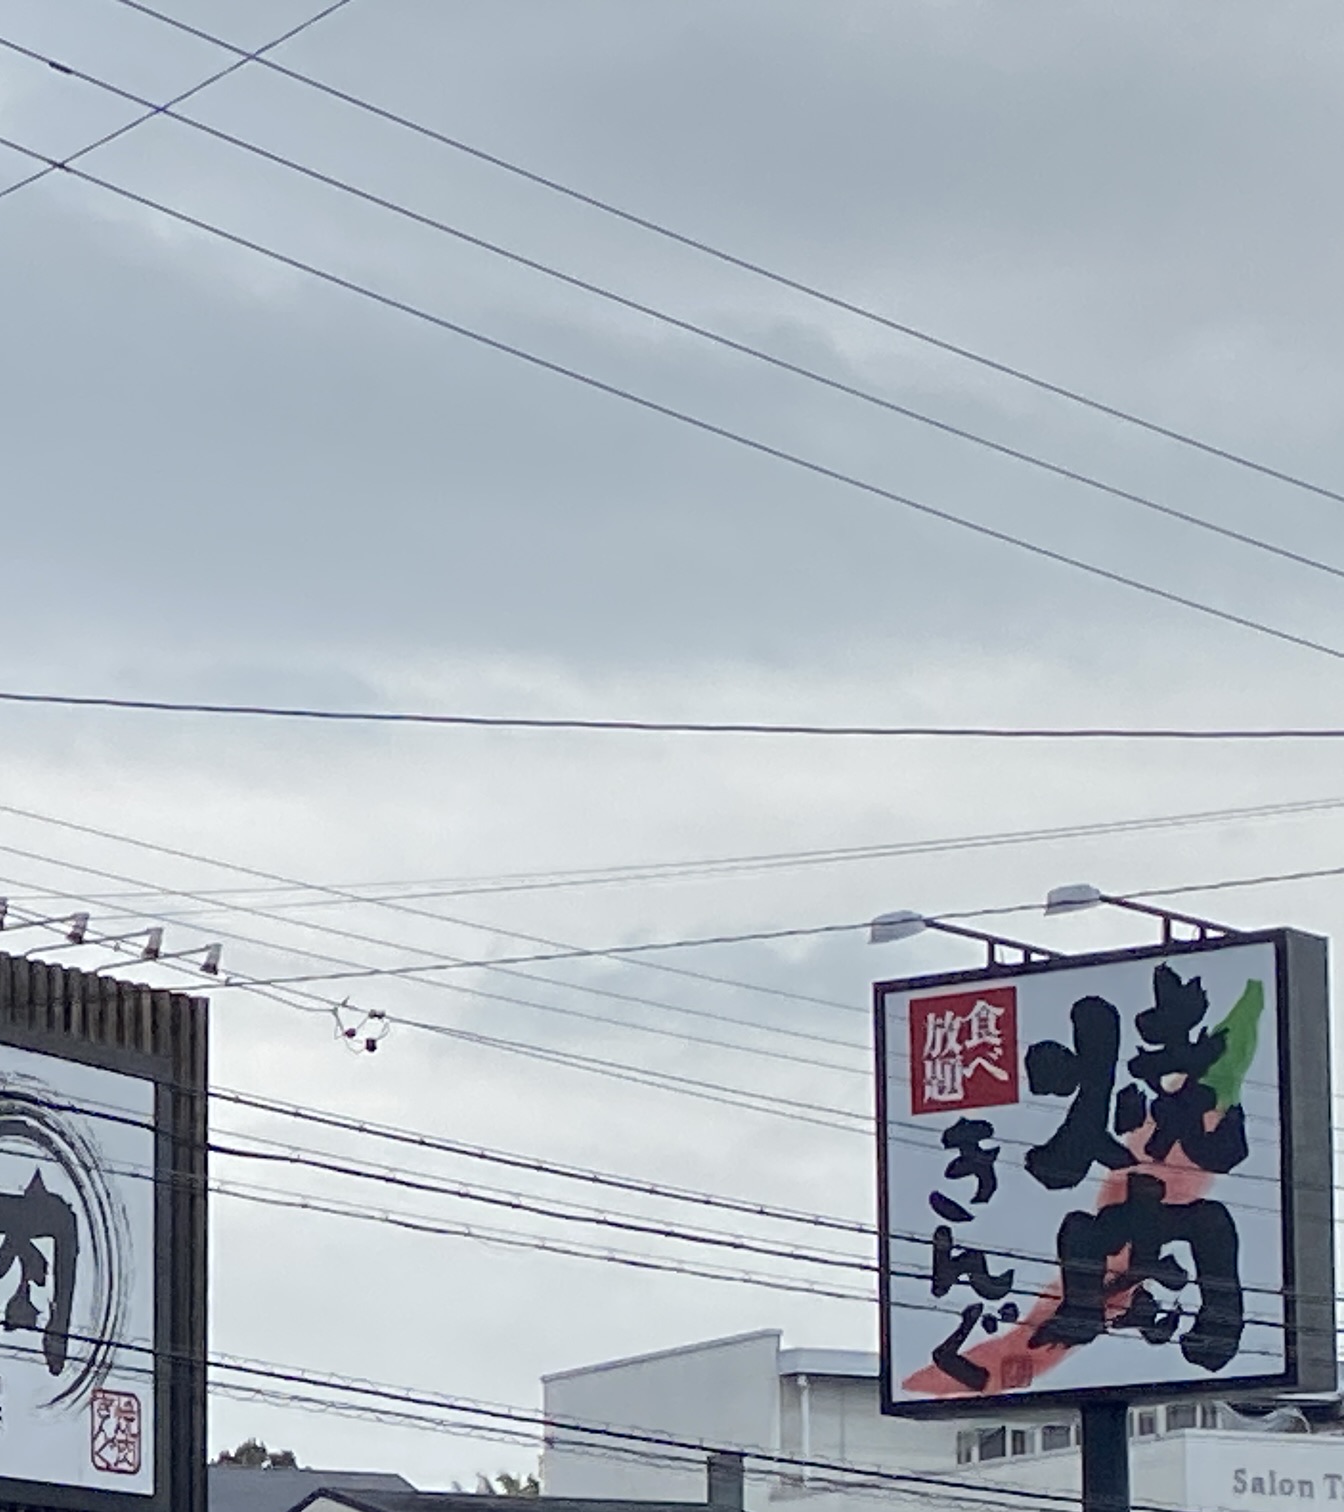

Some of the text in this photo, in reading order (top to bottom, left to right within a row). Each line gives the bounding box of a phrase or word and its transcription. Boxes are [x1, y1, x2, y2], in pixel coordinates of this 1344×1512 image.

[928, 1116, 1020, 1392] きんぐ
[1233, 1467, 1314, 1498] Salon
